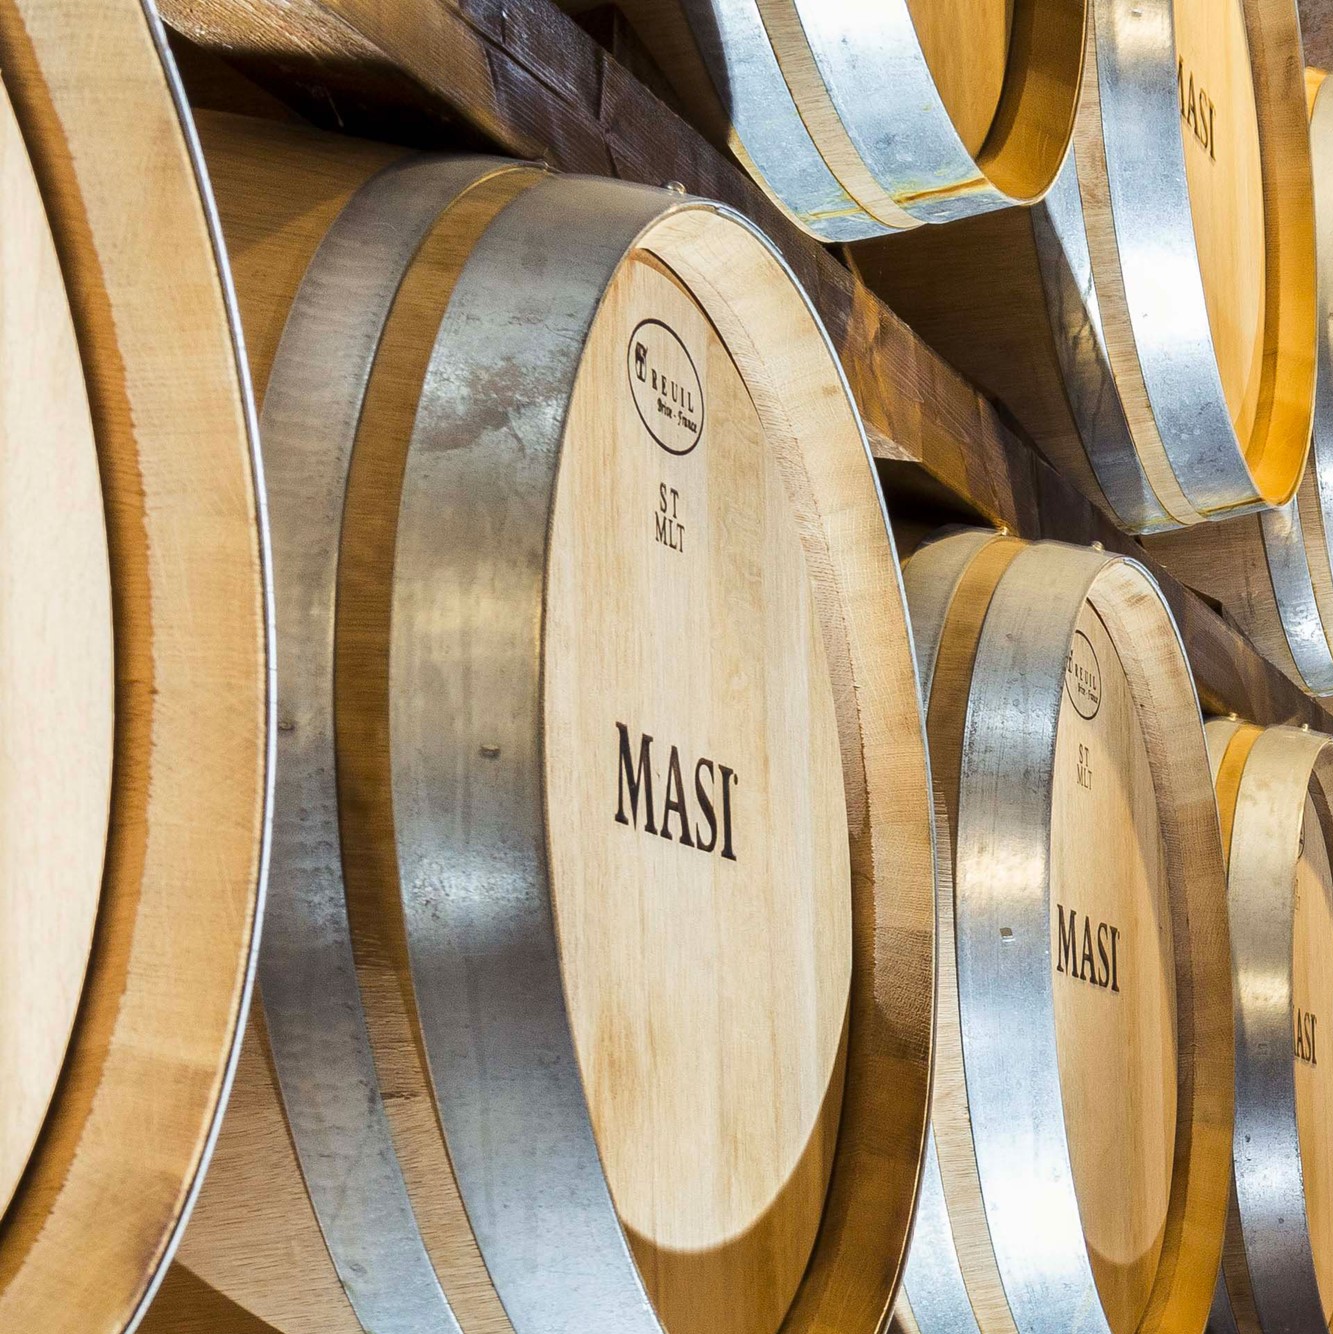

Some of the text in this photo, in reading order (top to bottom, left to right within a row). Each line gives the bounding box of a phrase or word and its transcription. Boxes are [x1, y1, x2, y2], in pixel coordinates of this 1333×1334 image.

[655, 511, 685, 553] MLT
[615, 721, 738, 861] MASI
[1077, 763, 1092, 790] MLT
[1057, 904, 1120, 992] MASI
